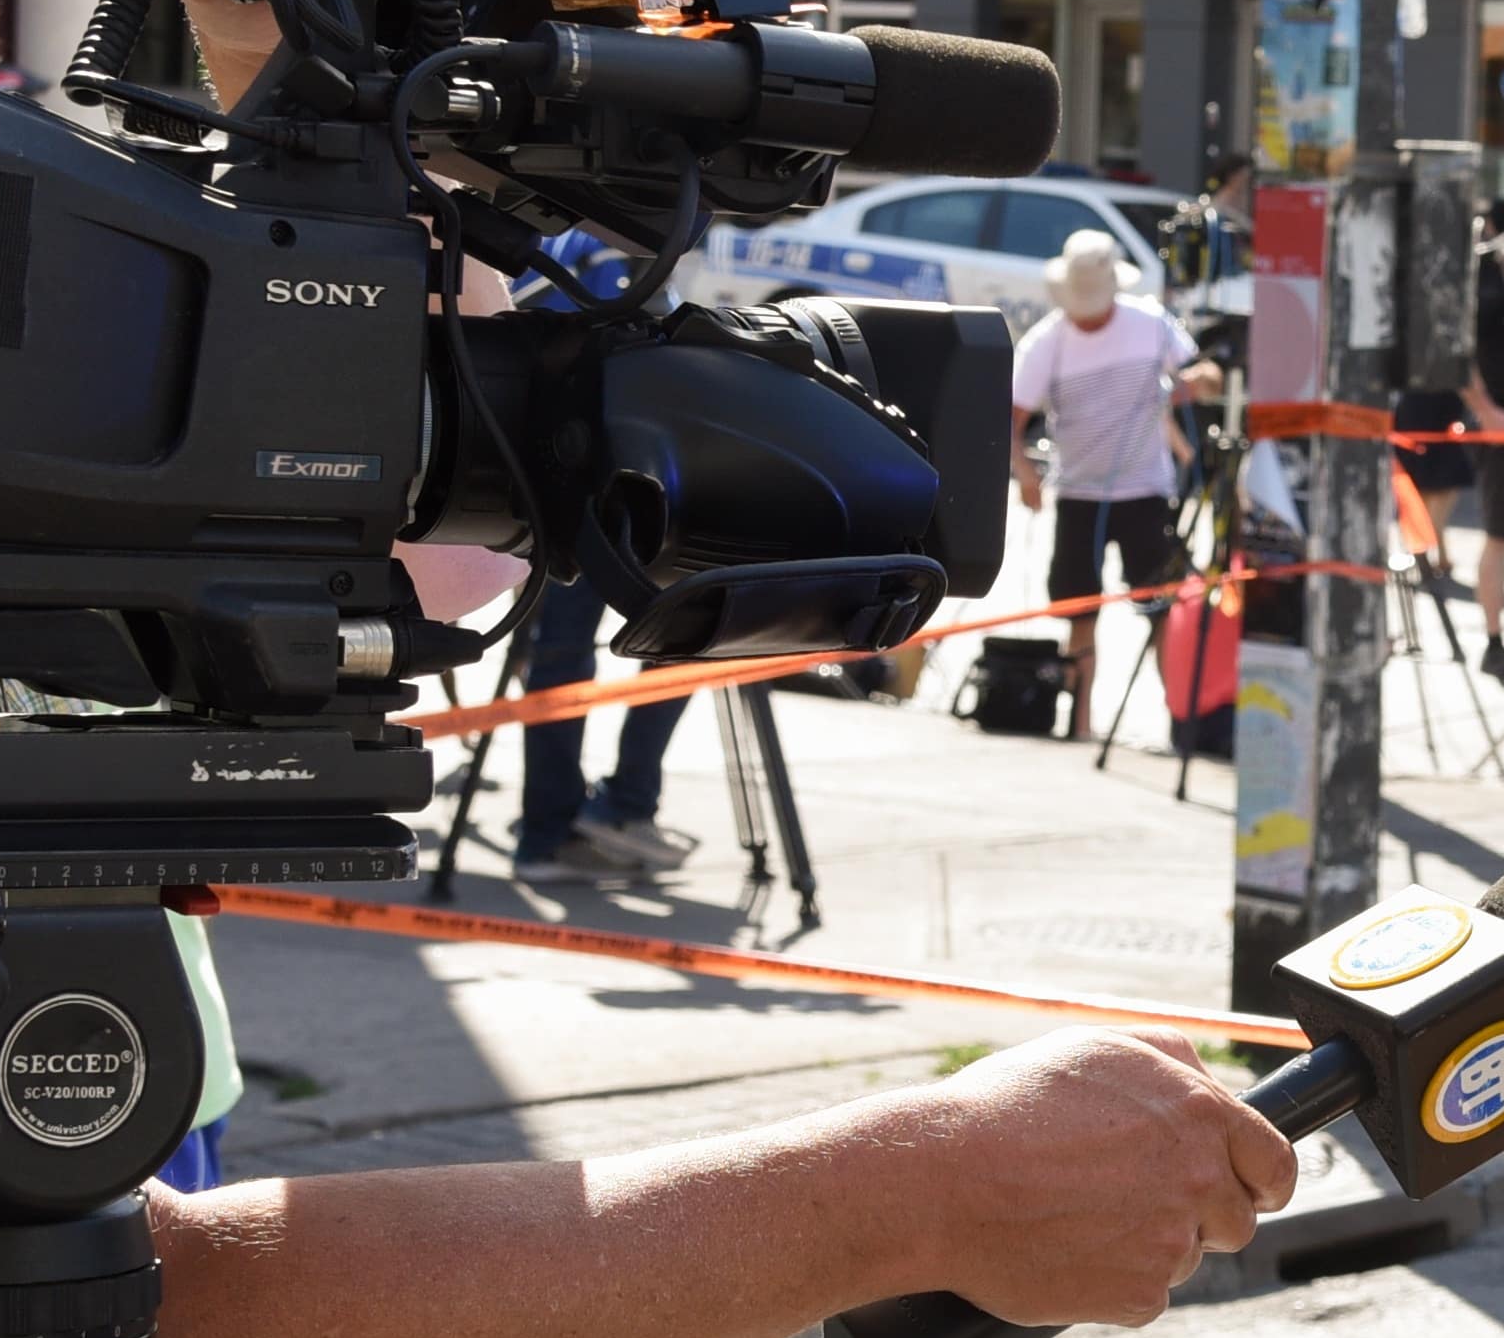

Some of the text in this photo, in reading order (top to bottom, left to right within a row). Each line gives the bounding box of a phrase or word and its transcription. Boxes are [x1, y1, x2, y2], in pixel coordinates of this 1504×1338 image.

[266, 279, 386, 307] SONY
[270, 454, 368, 478] Exmor
[31, 866, 37, 878] 1
[62, 865, 71, 878] 2
[94, 865, 103, 878] 3
[125, 865, 134, 876] 4
[157, 864, 166, 877] 5
[188, 863, 197, 876] 6
[220, 863, 228, 875] 7
[251, 862, 259, 875] 8
[282, 862, 290, 875] 9
[310, 861, 324, 874] 10
[341, 861, 353, 872] 11
[371, 860, 385, 873] 12
